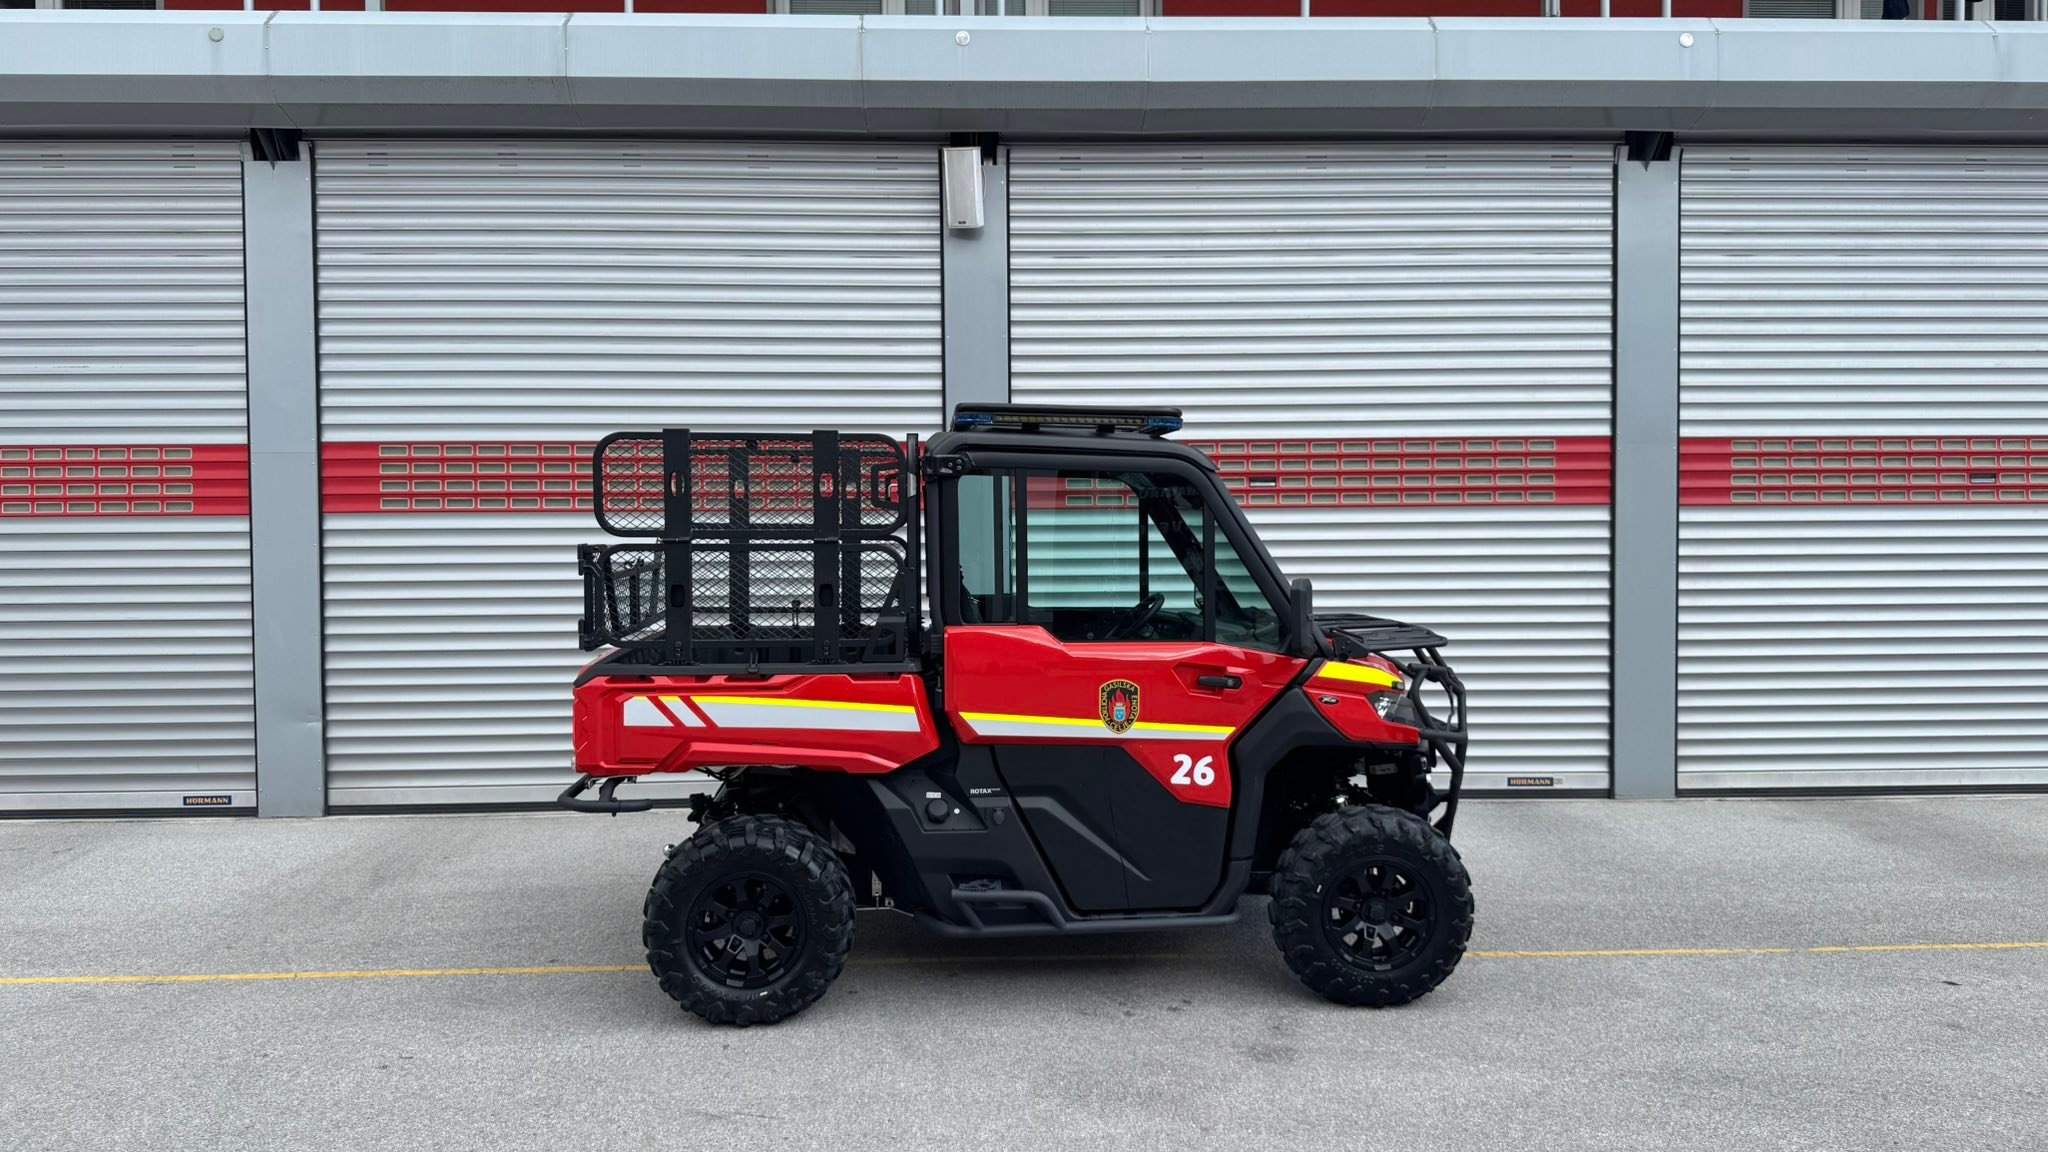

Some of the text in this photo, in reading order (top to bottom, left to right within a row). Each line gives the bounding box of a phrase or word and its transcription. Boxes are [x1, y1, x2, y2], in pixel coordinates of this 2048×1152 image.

[1103, 681, 1135, 692] GASILSKA
[1128, 695, 1138, 720] ENOTA
[1110, 721, 1130, 731] CELJE
[1170, 753, 1215, 787] 26
